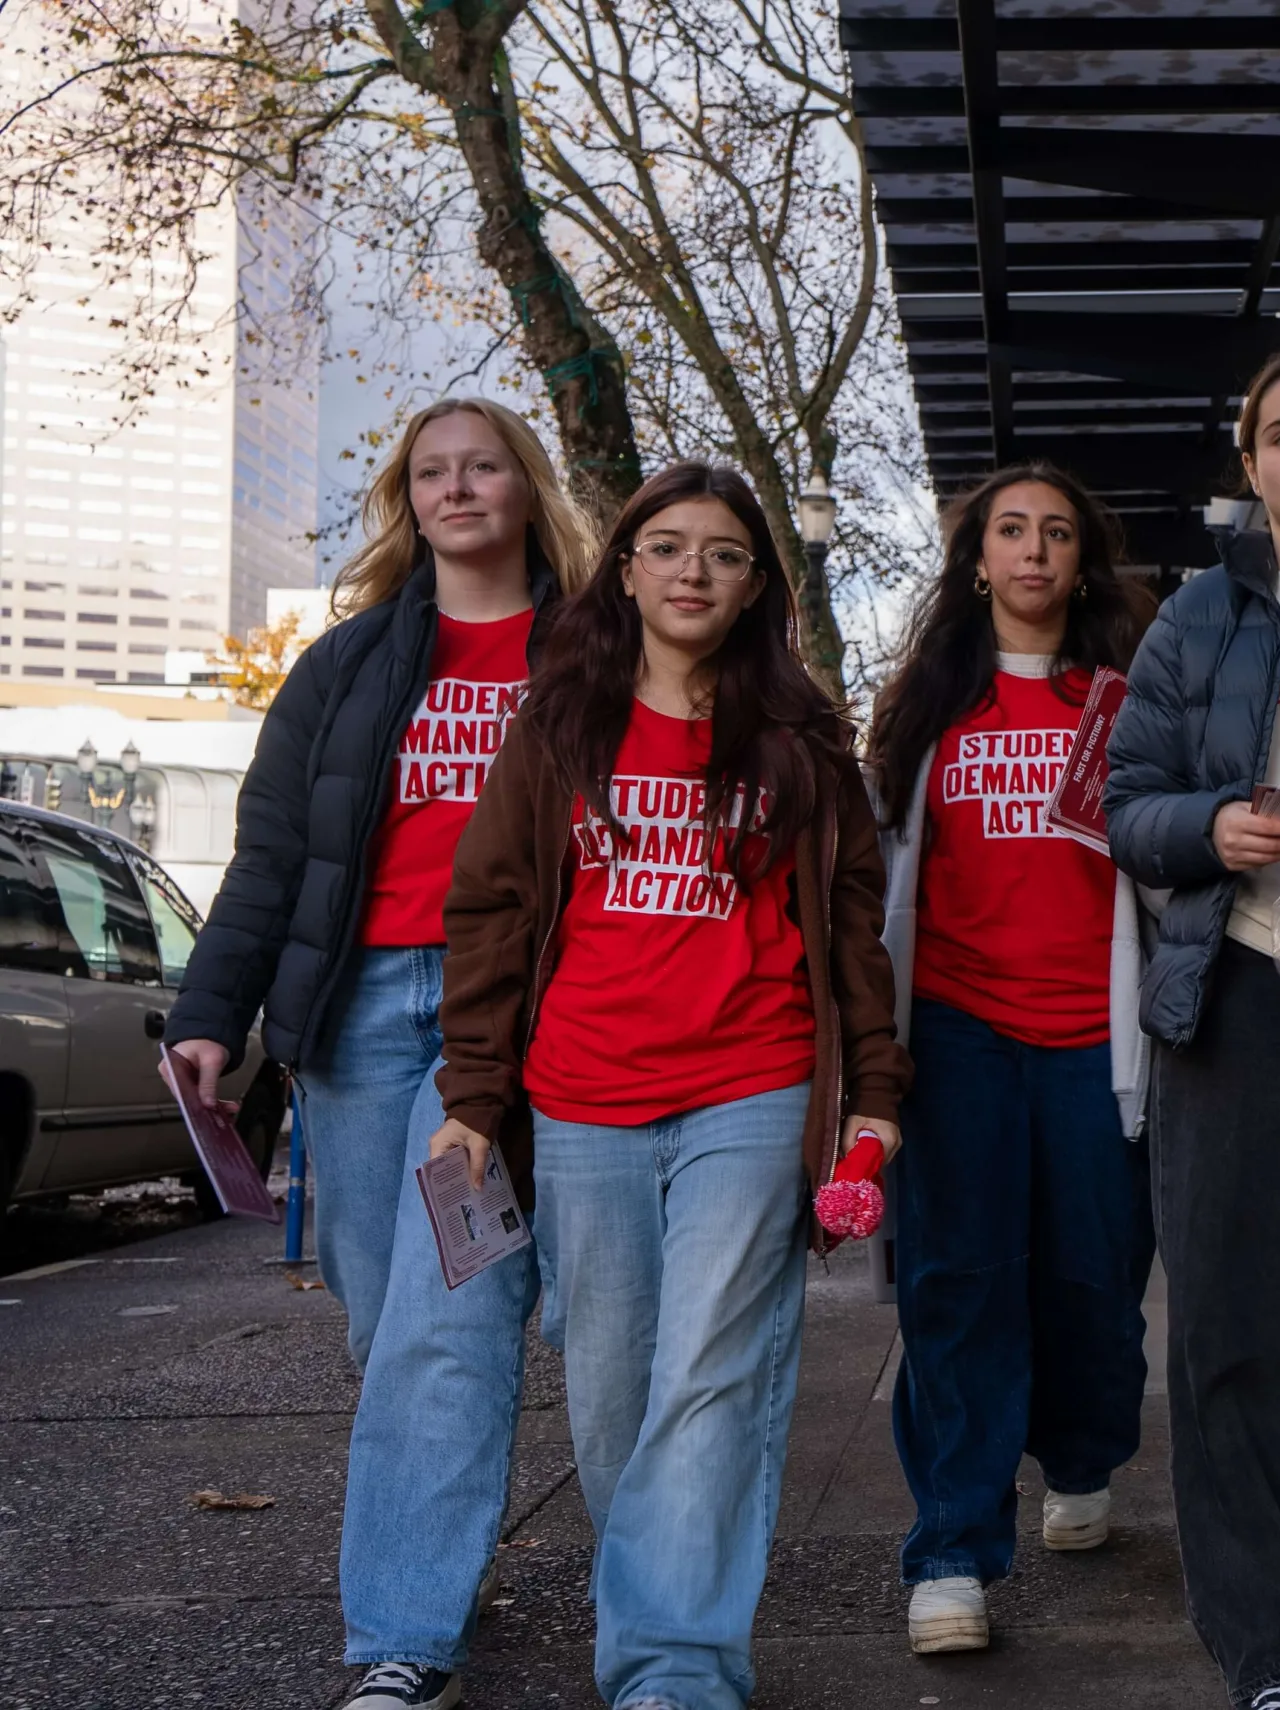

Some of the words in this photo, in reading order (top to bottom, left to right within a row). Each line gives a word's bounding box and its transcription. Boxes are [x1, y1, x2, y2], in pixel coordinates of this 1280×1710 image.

[1086, 714, 1105, 750] FICTION?
[1072, 761, 1087, 783] FACT
[1081, 749, 1092, 763] OR
[988, 800, 1053, 834] ACT
[608, 868, 735, 915] ACTION
